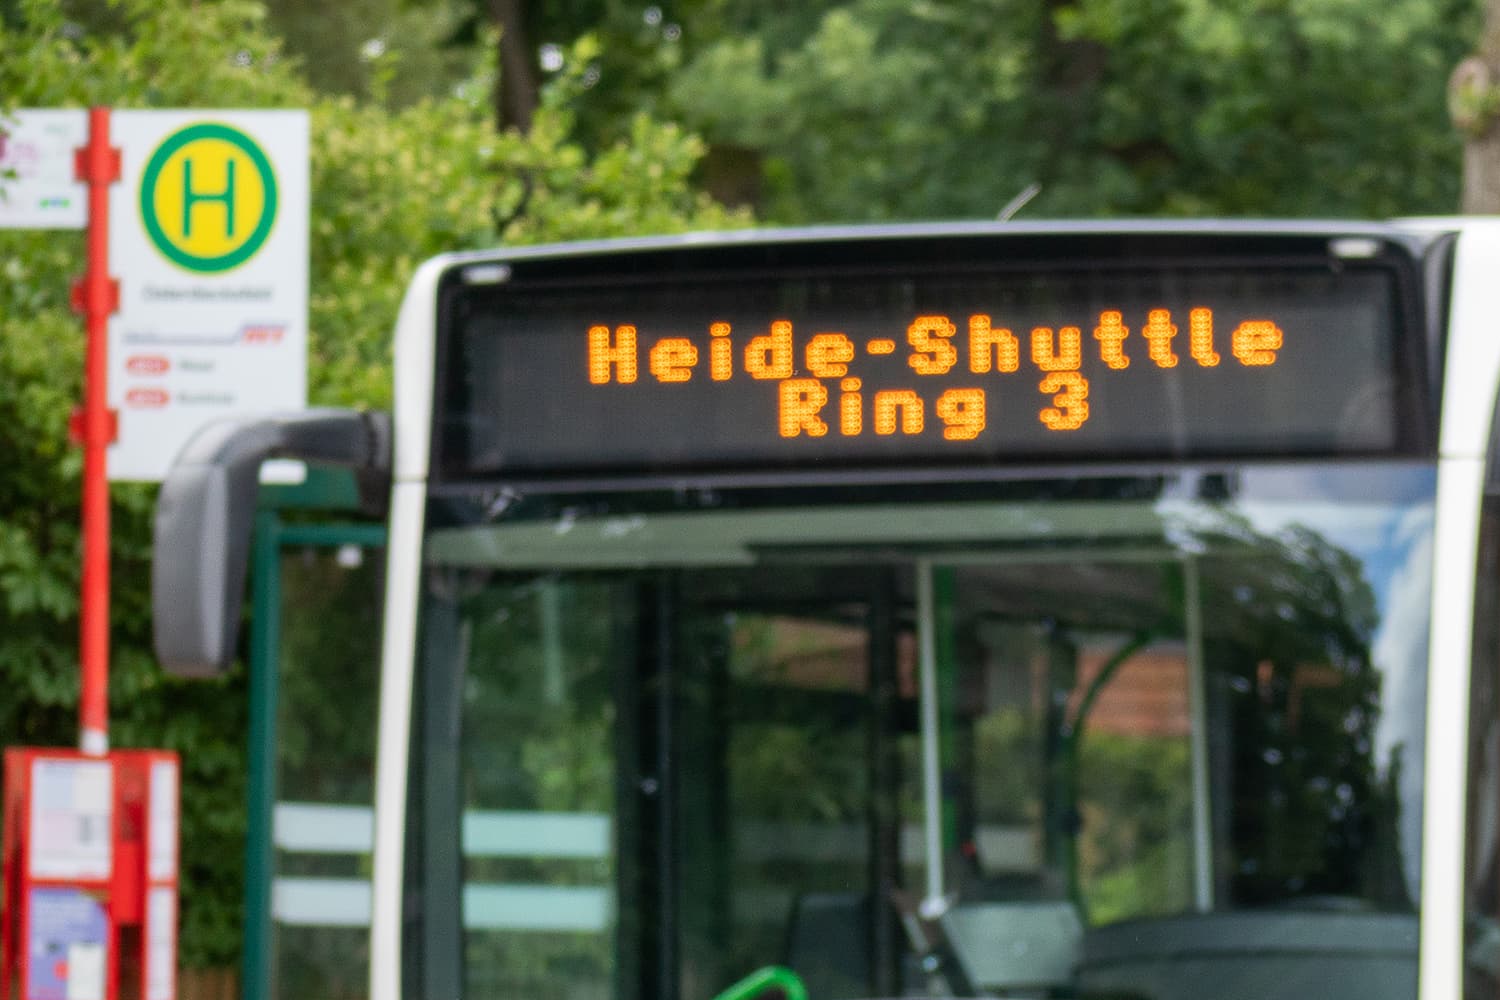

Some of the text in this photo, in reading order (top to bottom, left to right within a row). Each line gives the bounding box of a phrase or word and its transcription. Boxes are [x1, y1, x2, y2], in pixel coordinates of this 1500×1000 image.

[183, 157, 236, 240] H
[588, 307, 1283, 384] Heide-Shuttle
[779, 370, 1090, 440] Ring 3
